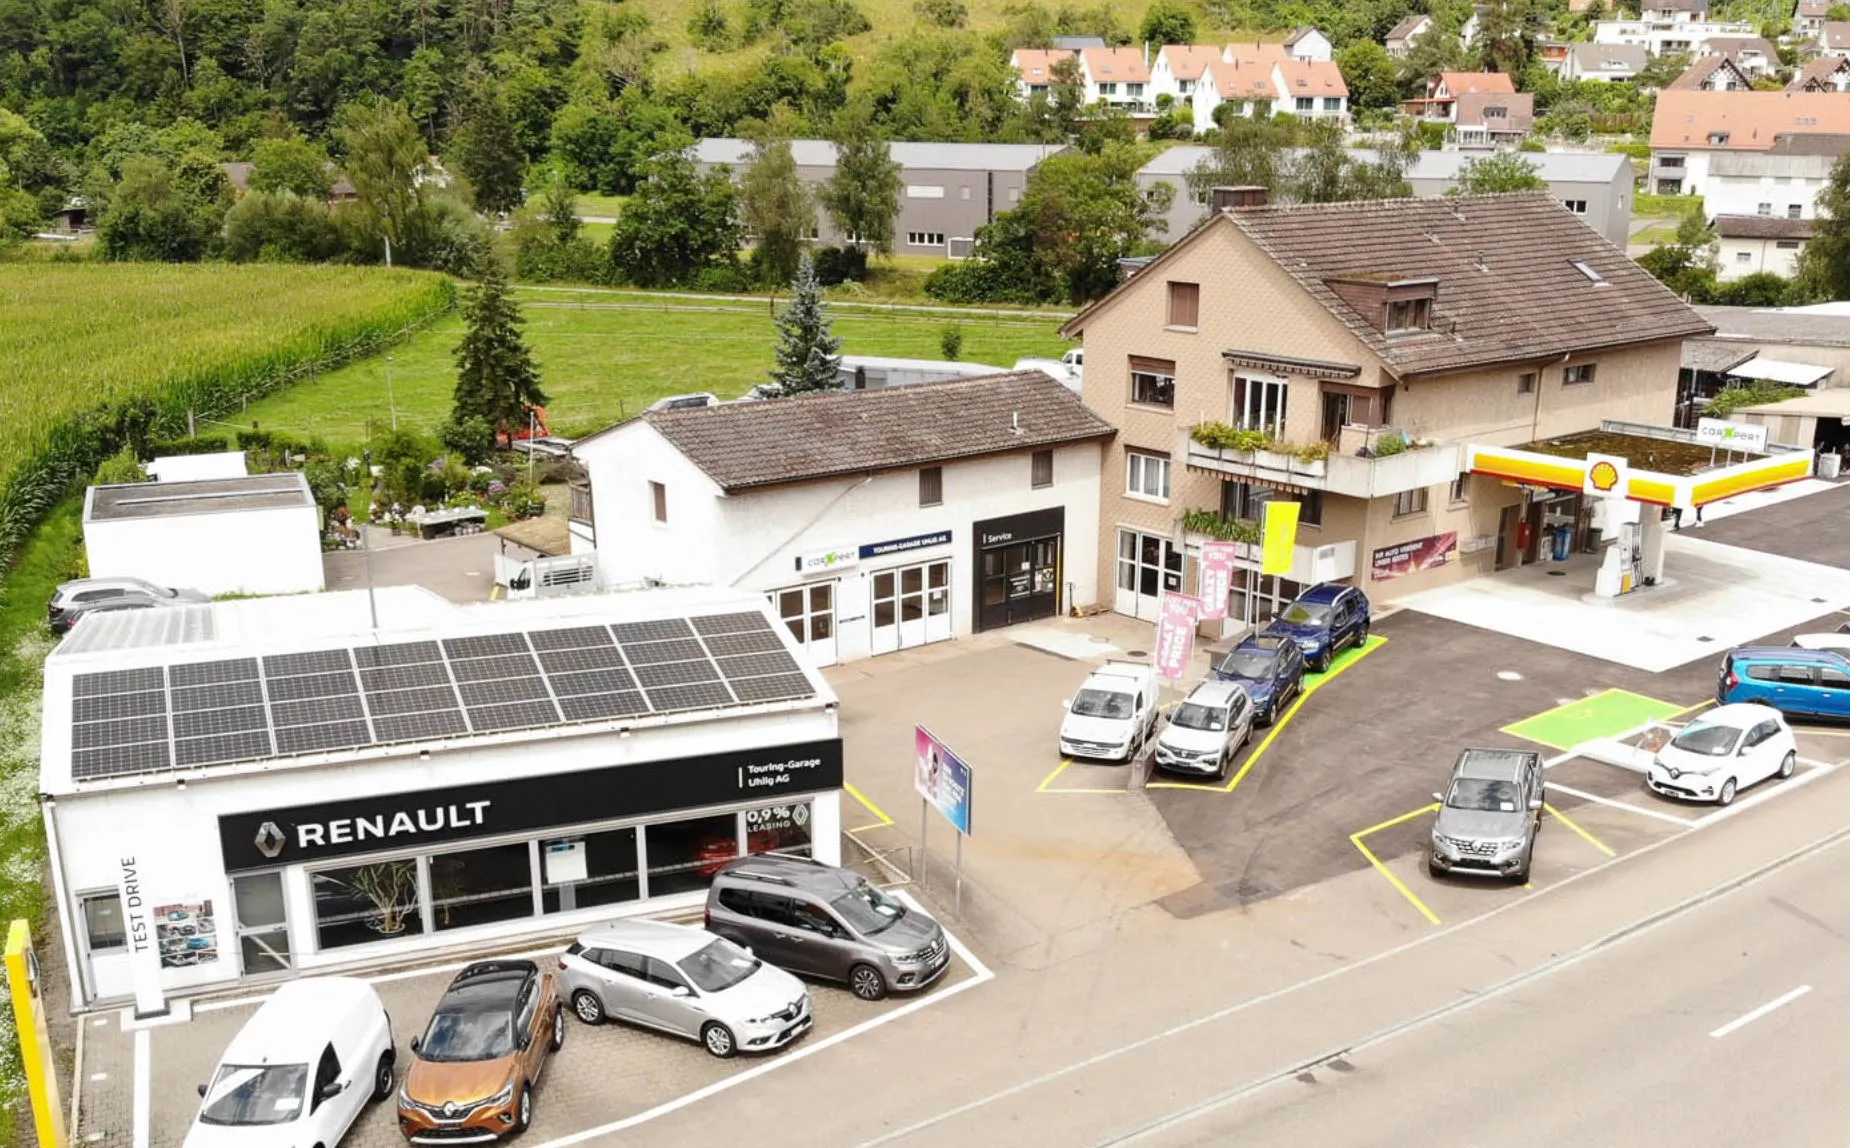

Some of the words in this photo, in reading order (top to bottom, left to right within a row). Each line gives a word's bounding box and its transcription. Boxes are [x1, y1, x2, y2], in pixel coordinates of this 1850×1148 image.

[988, 532, 1012, 543] Service
[747, 758, 821, 774] Touring-Garage
[747, 776, 775, 787] Uhlig
[775, 773, 790, 783] AG
[296, 799, 492, 849] RENAULT
[747, 820, 791, 833] LEASING
[121, 855, 143, 909] DRIVE
[129, 912, 149, 953] TEST
